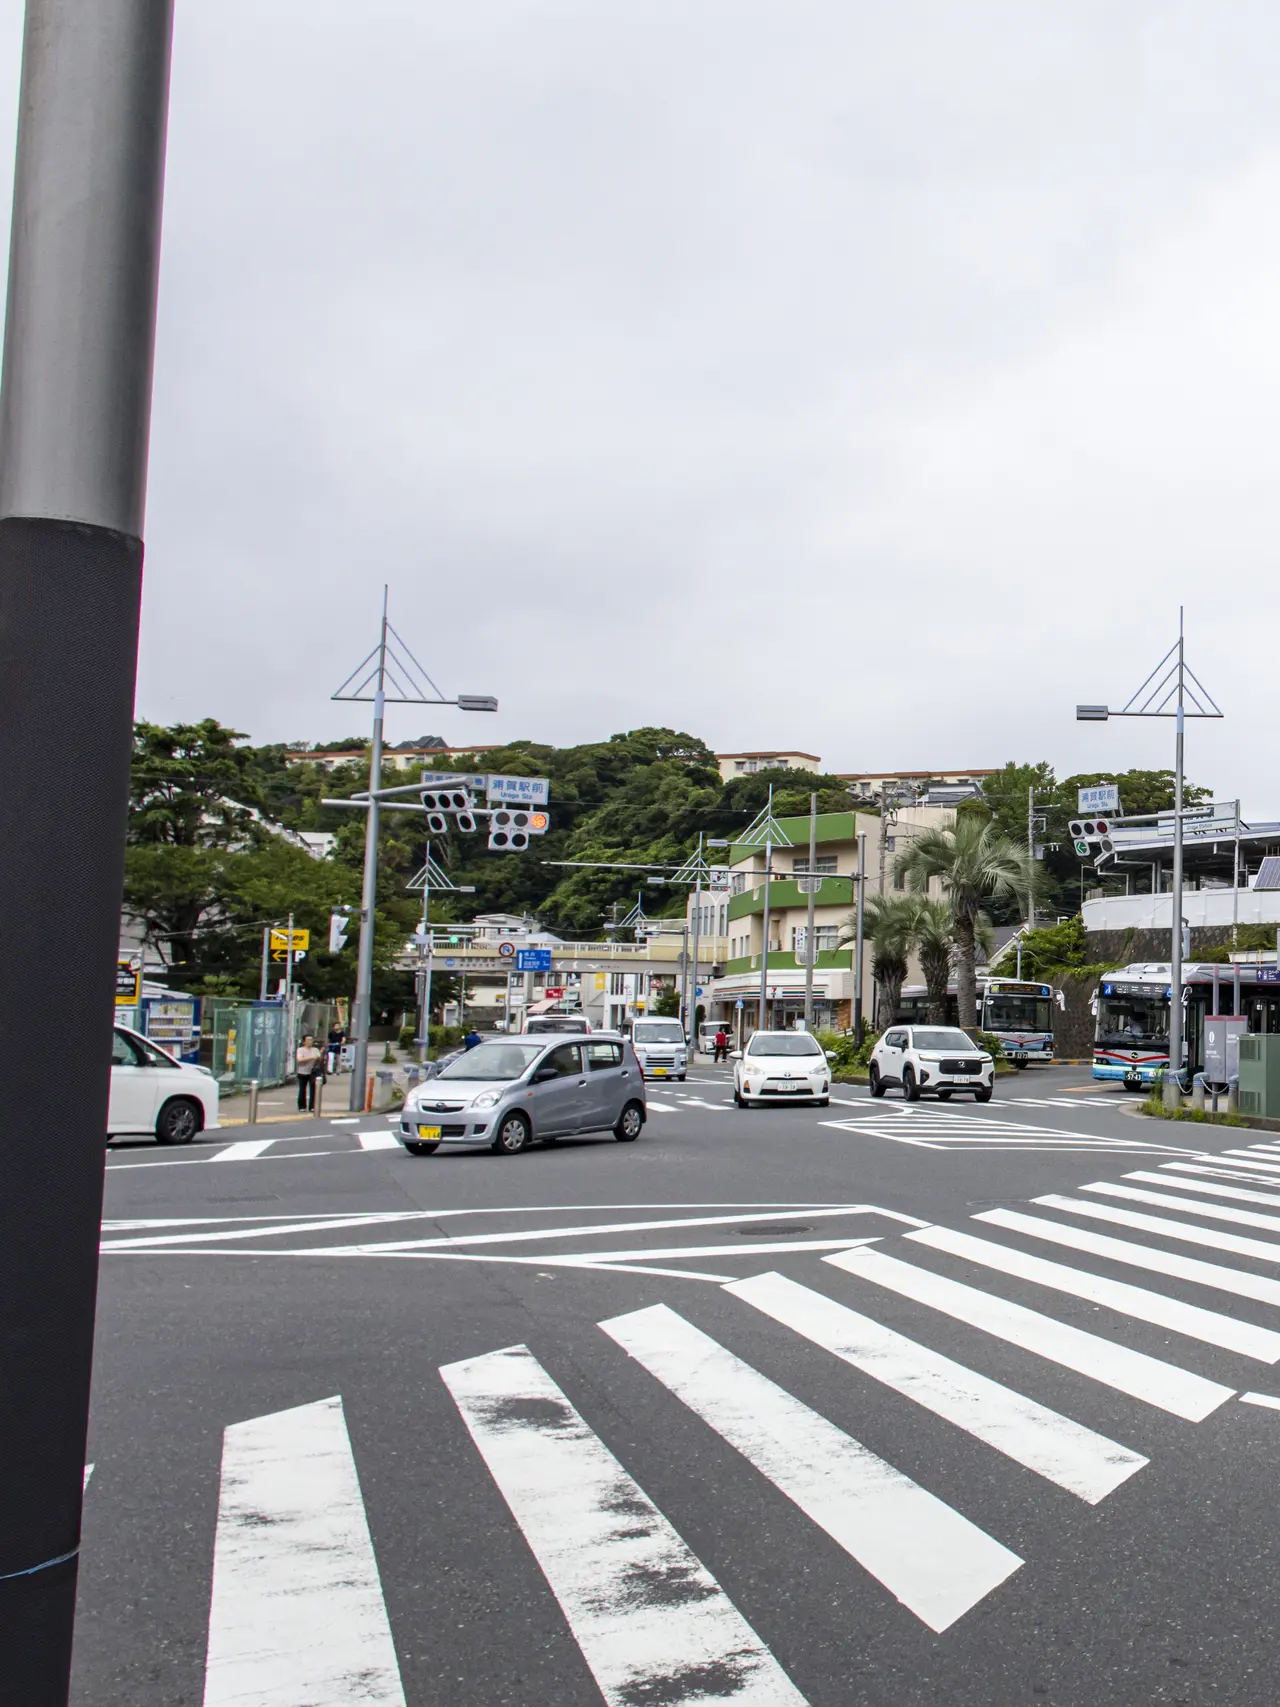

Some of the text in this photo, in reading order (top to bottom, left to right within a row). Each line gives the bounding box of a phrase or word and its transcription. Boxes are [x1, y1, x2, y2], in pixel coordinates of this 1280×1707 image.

[492, 780, 543, 793] 浦賀駅前
[1081, 788, 1115, 802] 浦賀駅前
[295, 950, 306, 962] P
